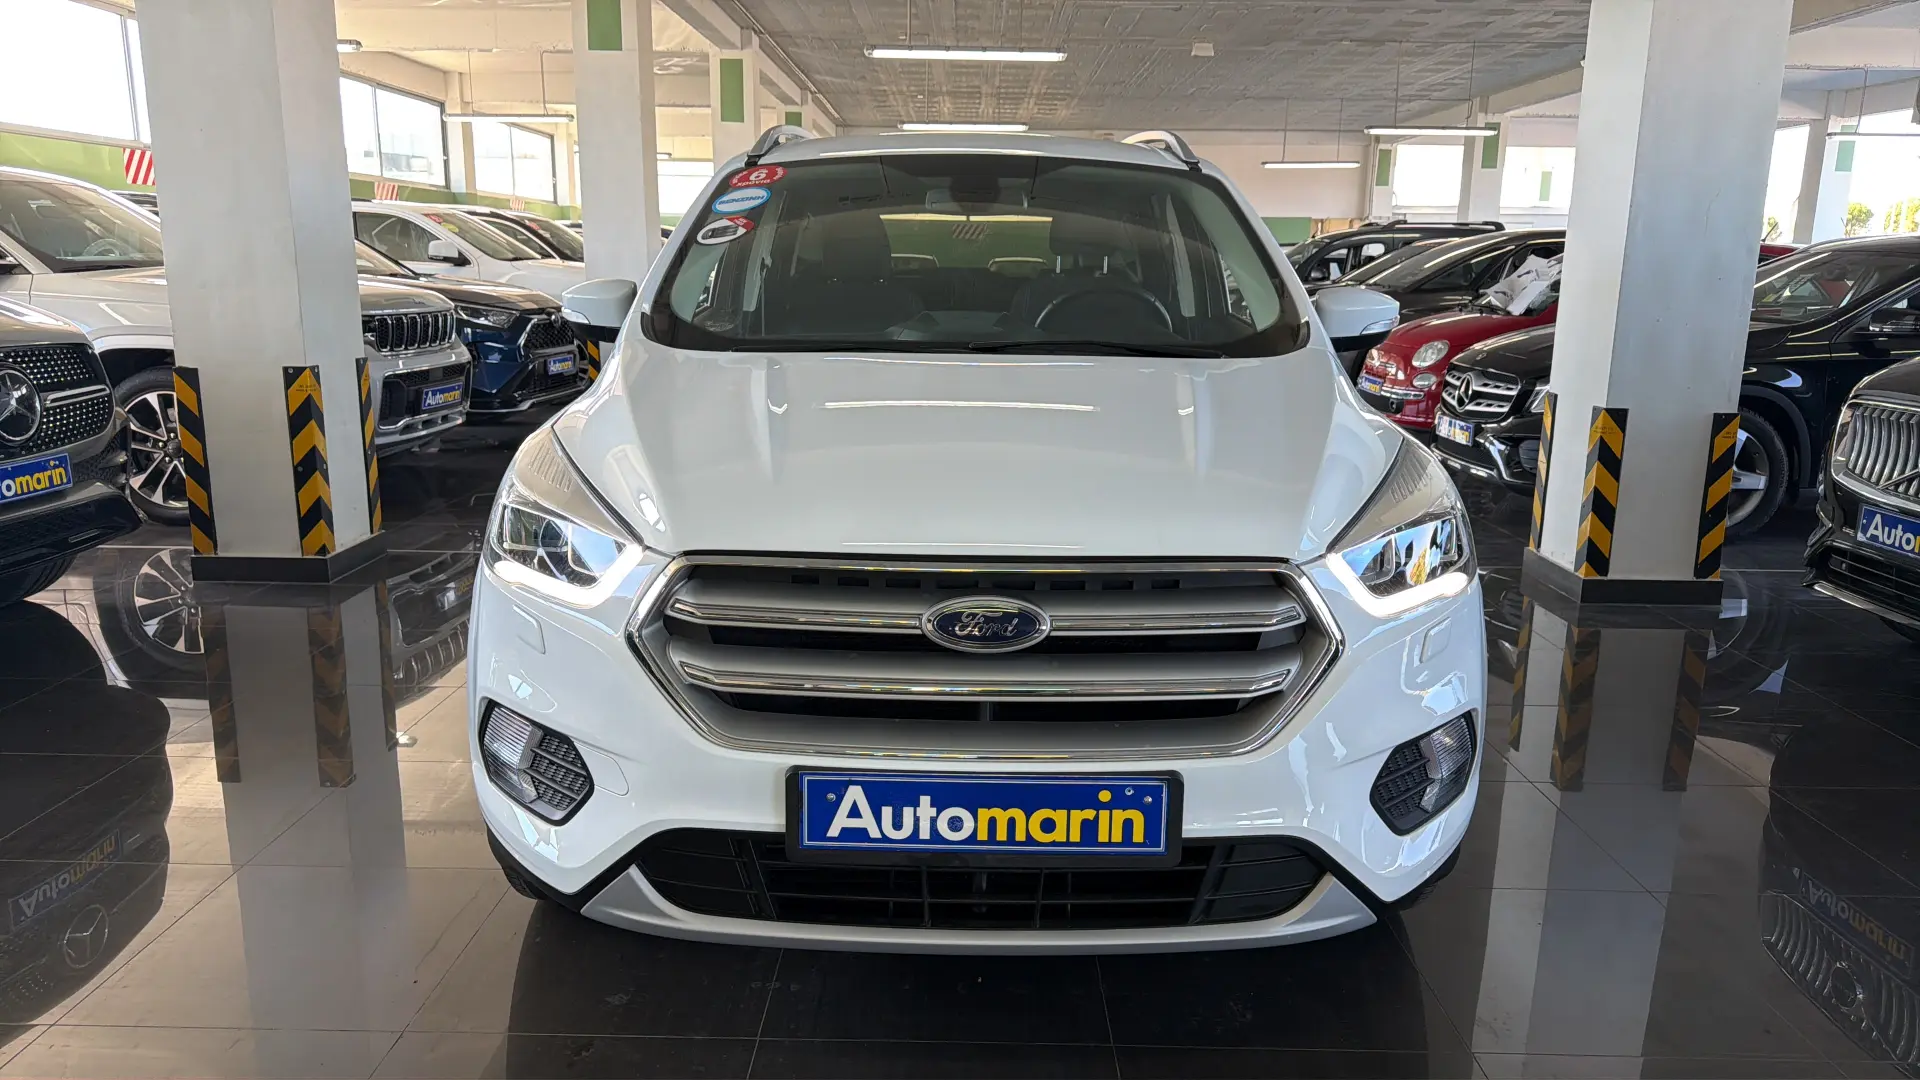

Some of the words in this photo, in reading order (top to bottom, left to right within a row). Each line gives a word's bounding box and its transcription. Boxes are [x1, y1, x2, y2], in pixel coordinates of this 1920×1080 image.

[749, 169, 769, 181] 6
[0, 460, 68, 497] omarin
[954, 610, 1018, 637] Ford
[825, 784, 1145, 844] Automarin
